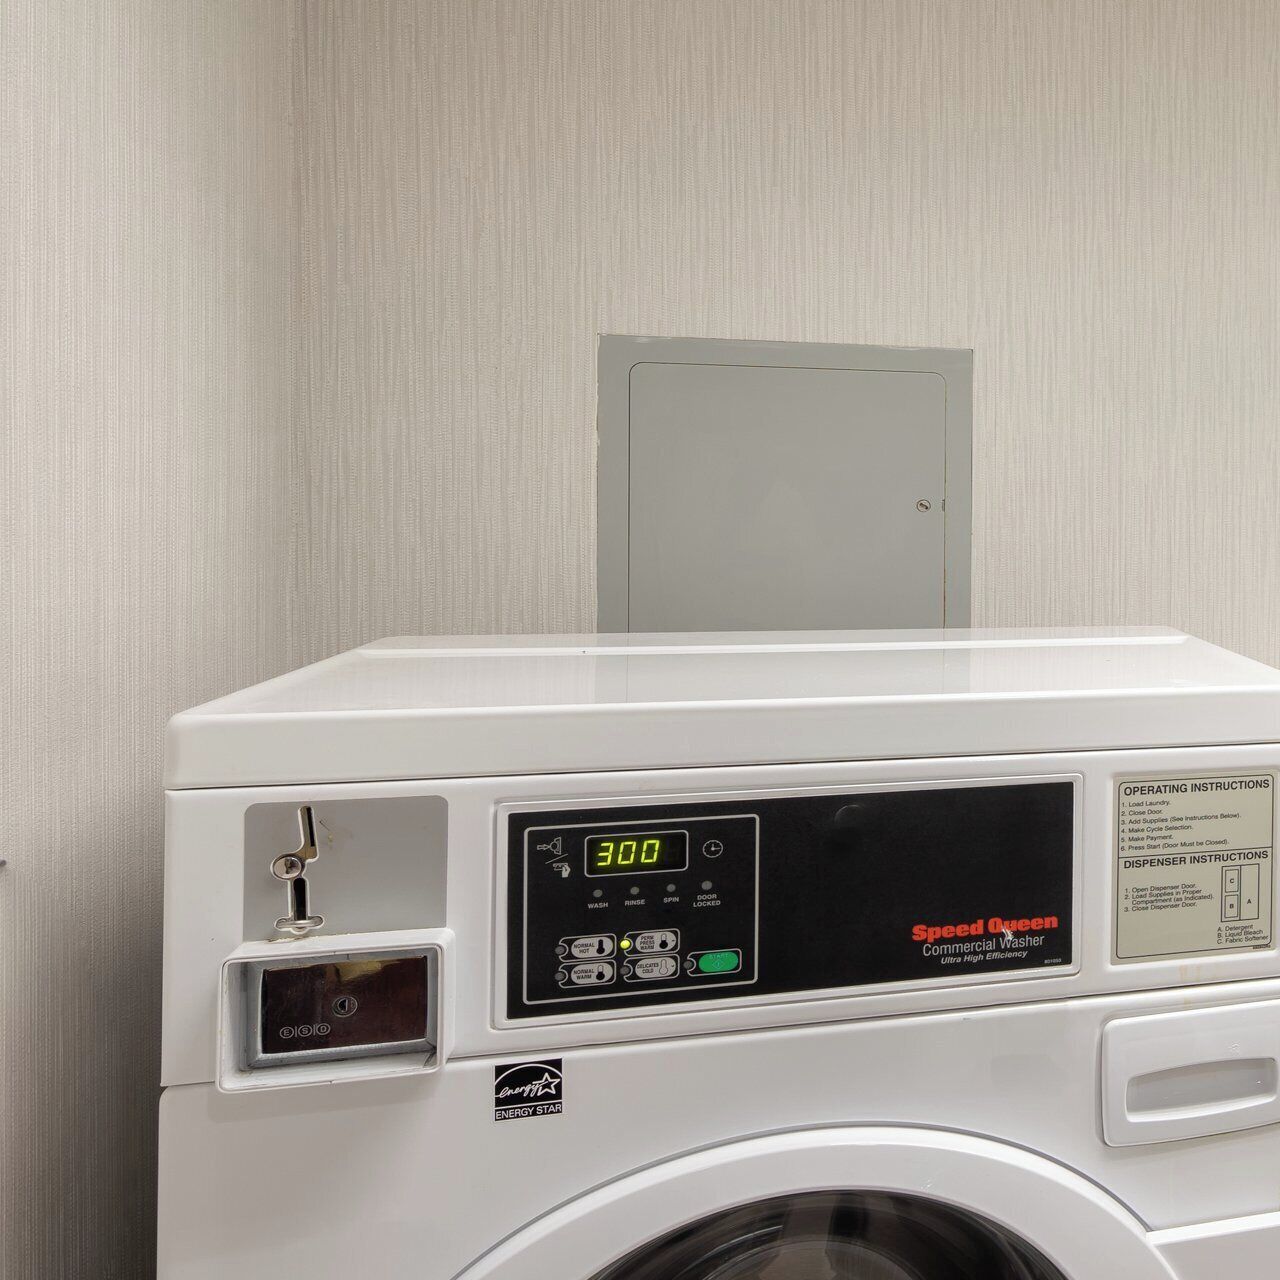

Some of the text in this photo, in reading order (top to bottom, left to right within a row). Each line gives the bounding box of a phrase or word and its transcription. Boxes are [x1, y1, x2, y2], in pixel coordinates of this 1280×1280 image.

[1124, 779, 1270, 796] OPERATING INSTRUCTIONS
[597, 839, 660, 866] 300
[1124, 851, 1269, 869] DISPENSER INSTRUCTIONS
[1132, 898, 1172, 906] Compartment
[912, 916, 1058, 943] Speed Queen
[1225, 924, 1253, 932] Detergent
[923, 935, 1045, 956] Commercial Washer
[941, 950, 1028, 964] Ultra High Efficiency
[496, 1104, 561, 1119] ENERGY STAR
